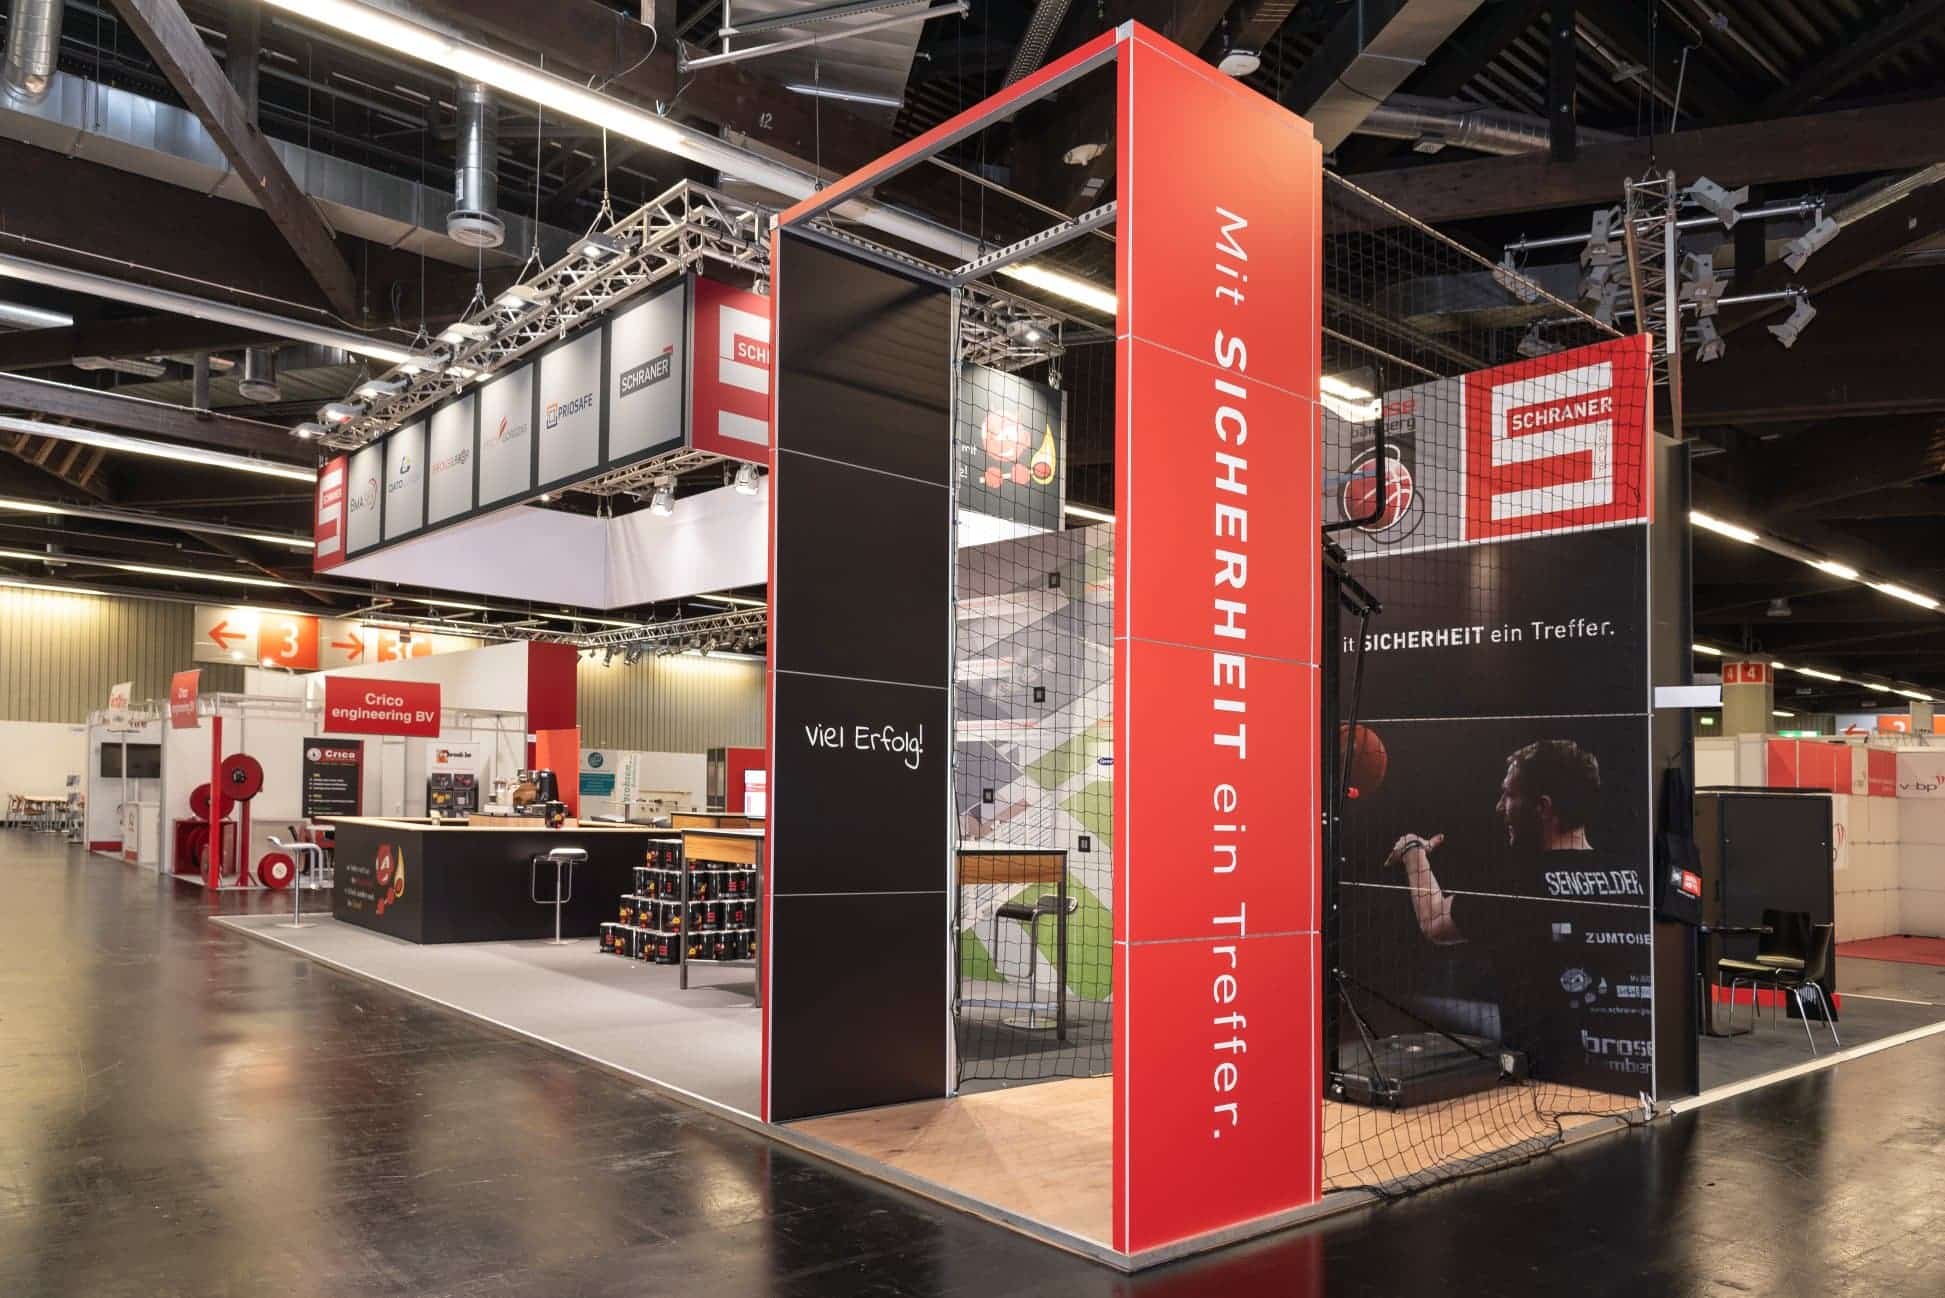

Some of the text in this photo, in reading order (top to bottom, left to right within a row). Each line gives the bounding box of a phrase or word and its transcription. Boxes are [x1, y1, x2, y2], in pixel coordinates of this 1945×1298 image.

[738, 342, 769, 365] SCH
[621, 359, 670, 393] SCHRANER
[558, 393, 593, 420] PRIOSAFE
[1512, 397, 1612, 431] SCHRANER
[279, 622, 300, 659] 3
[1364, 626, 1484, 652] SICHERHEIT
[1491, 624, 1522, 643] ein
[1531, 618, 1615, 641] Treffer.
[1213, 205, 1248, 1139] Mit SICHERHEIT ein Treffer.
[332, 707, 435, 724] engineering BV
[365, 692, 404, 707] Crico
[805, 724, 923, 769] Viel Erfolg!
[1545, 869, 1644, 896] SENGFELDER
